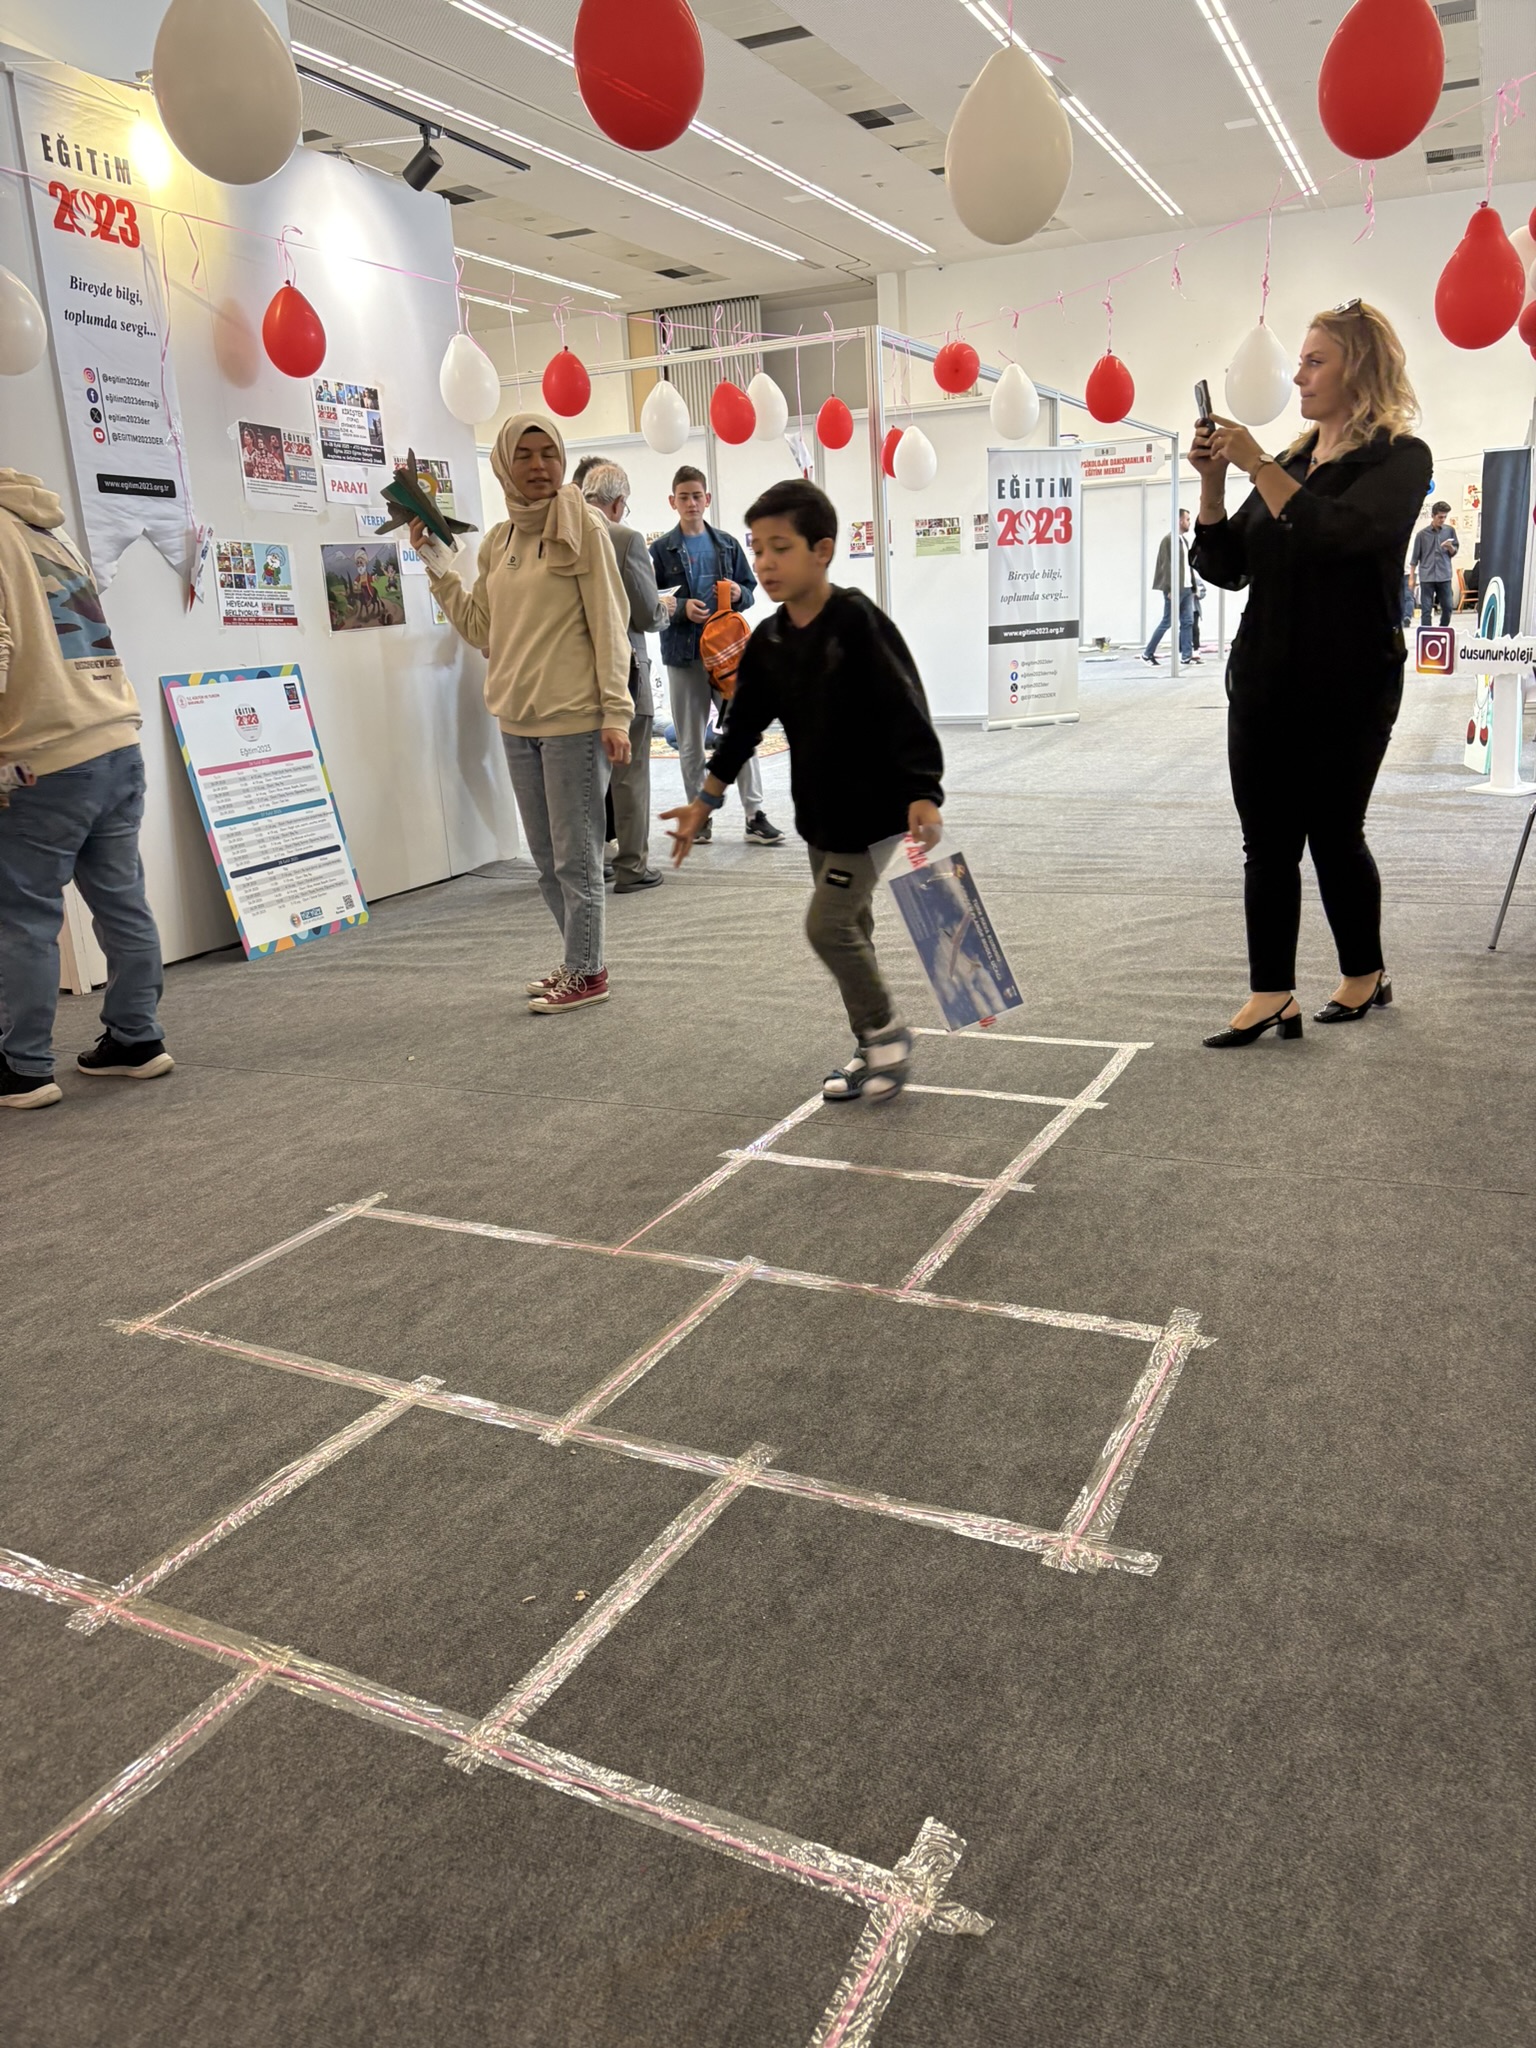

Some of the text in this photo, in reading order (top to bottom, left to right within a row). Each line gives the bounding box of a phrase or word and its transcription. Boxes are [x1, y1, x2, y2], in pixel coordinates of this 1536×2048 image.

[70, 275, 142, 306] Bireyde bilgi,
[64, 309, 156, 337] toplumda sevgi...
[104, 480, 170, 493] www.egitim2023.org.tr
[331, 480, 368, 494] PARAYI
[361, 516, 385, 526] VEREN
[1008, 568, 1062, 582] Bireyde bilgi,
[1000, 590, 1069, 603] toplumda sevgi...
[1003, 626, 1065, 638] www.egitim2023.org.tr
